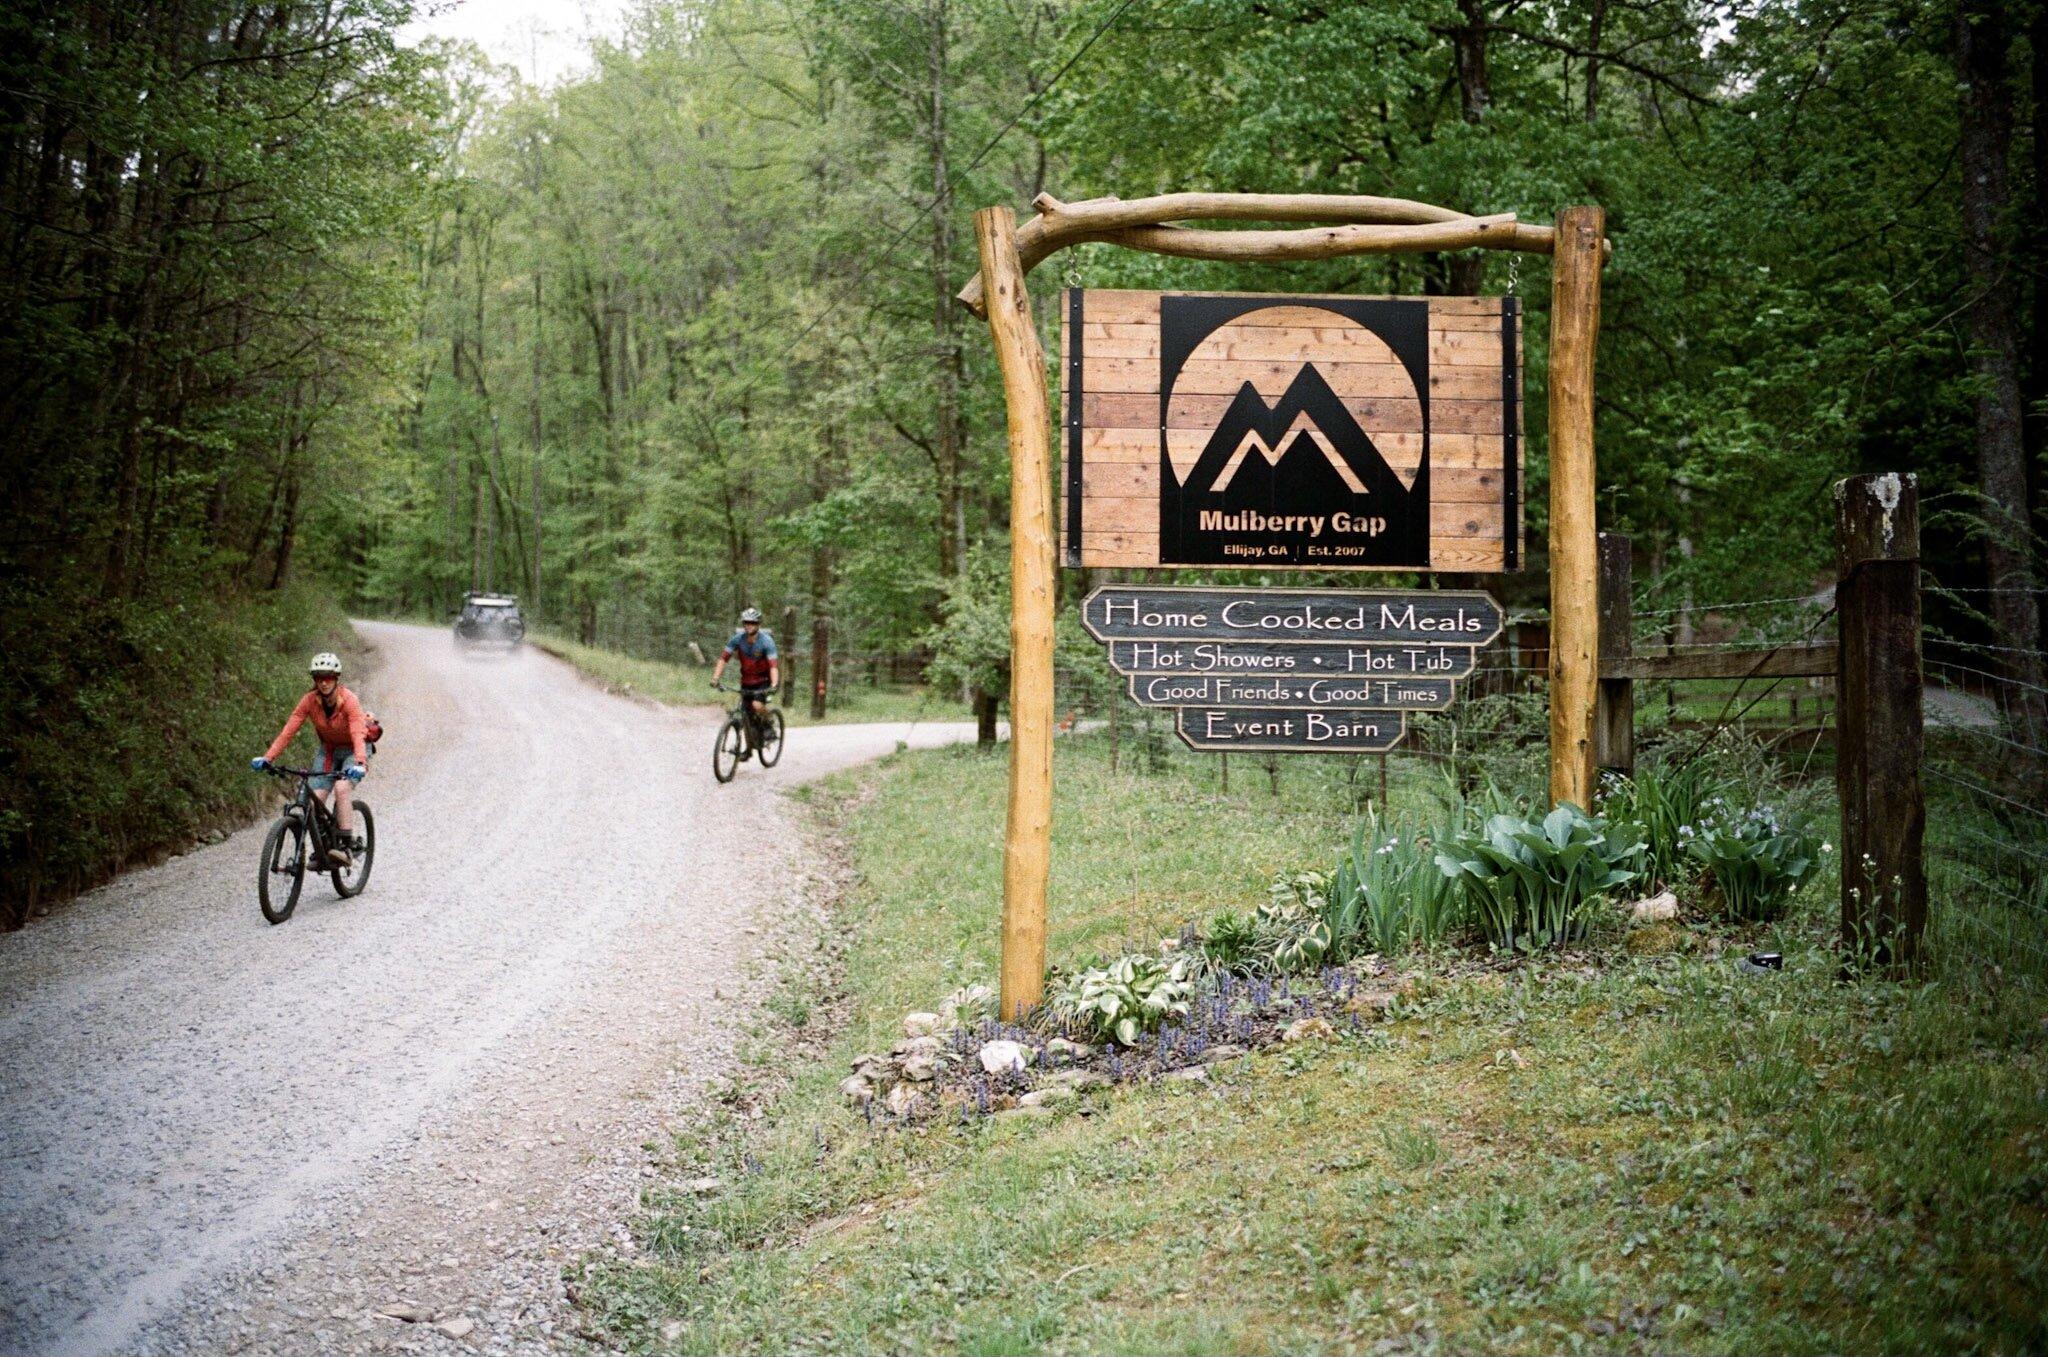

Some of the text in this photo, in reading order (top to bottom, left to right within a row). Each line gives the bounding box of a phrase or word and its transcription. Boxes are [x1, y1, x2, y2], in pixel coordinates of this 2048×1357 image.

[1199, 510, 1387, 538] Mulberry Gap
[1224, 545, 1366, 557] Ellijay, GA Est. 2007
[1104, 598, 1482, 633] Home Cooked Meals
[1133, 643, 1453, 671] Hot Showers Hot Tub
[1147, 677, 1438, 704] Good Friends Good Times
[1206, 711, 1379, 742] Event Barn
